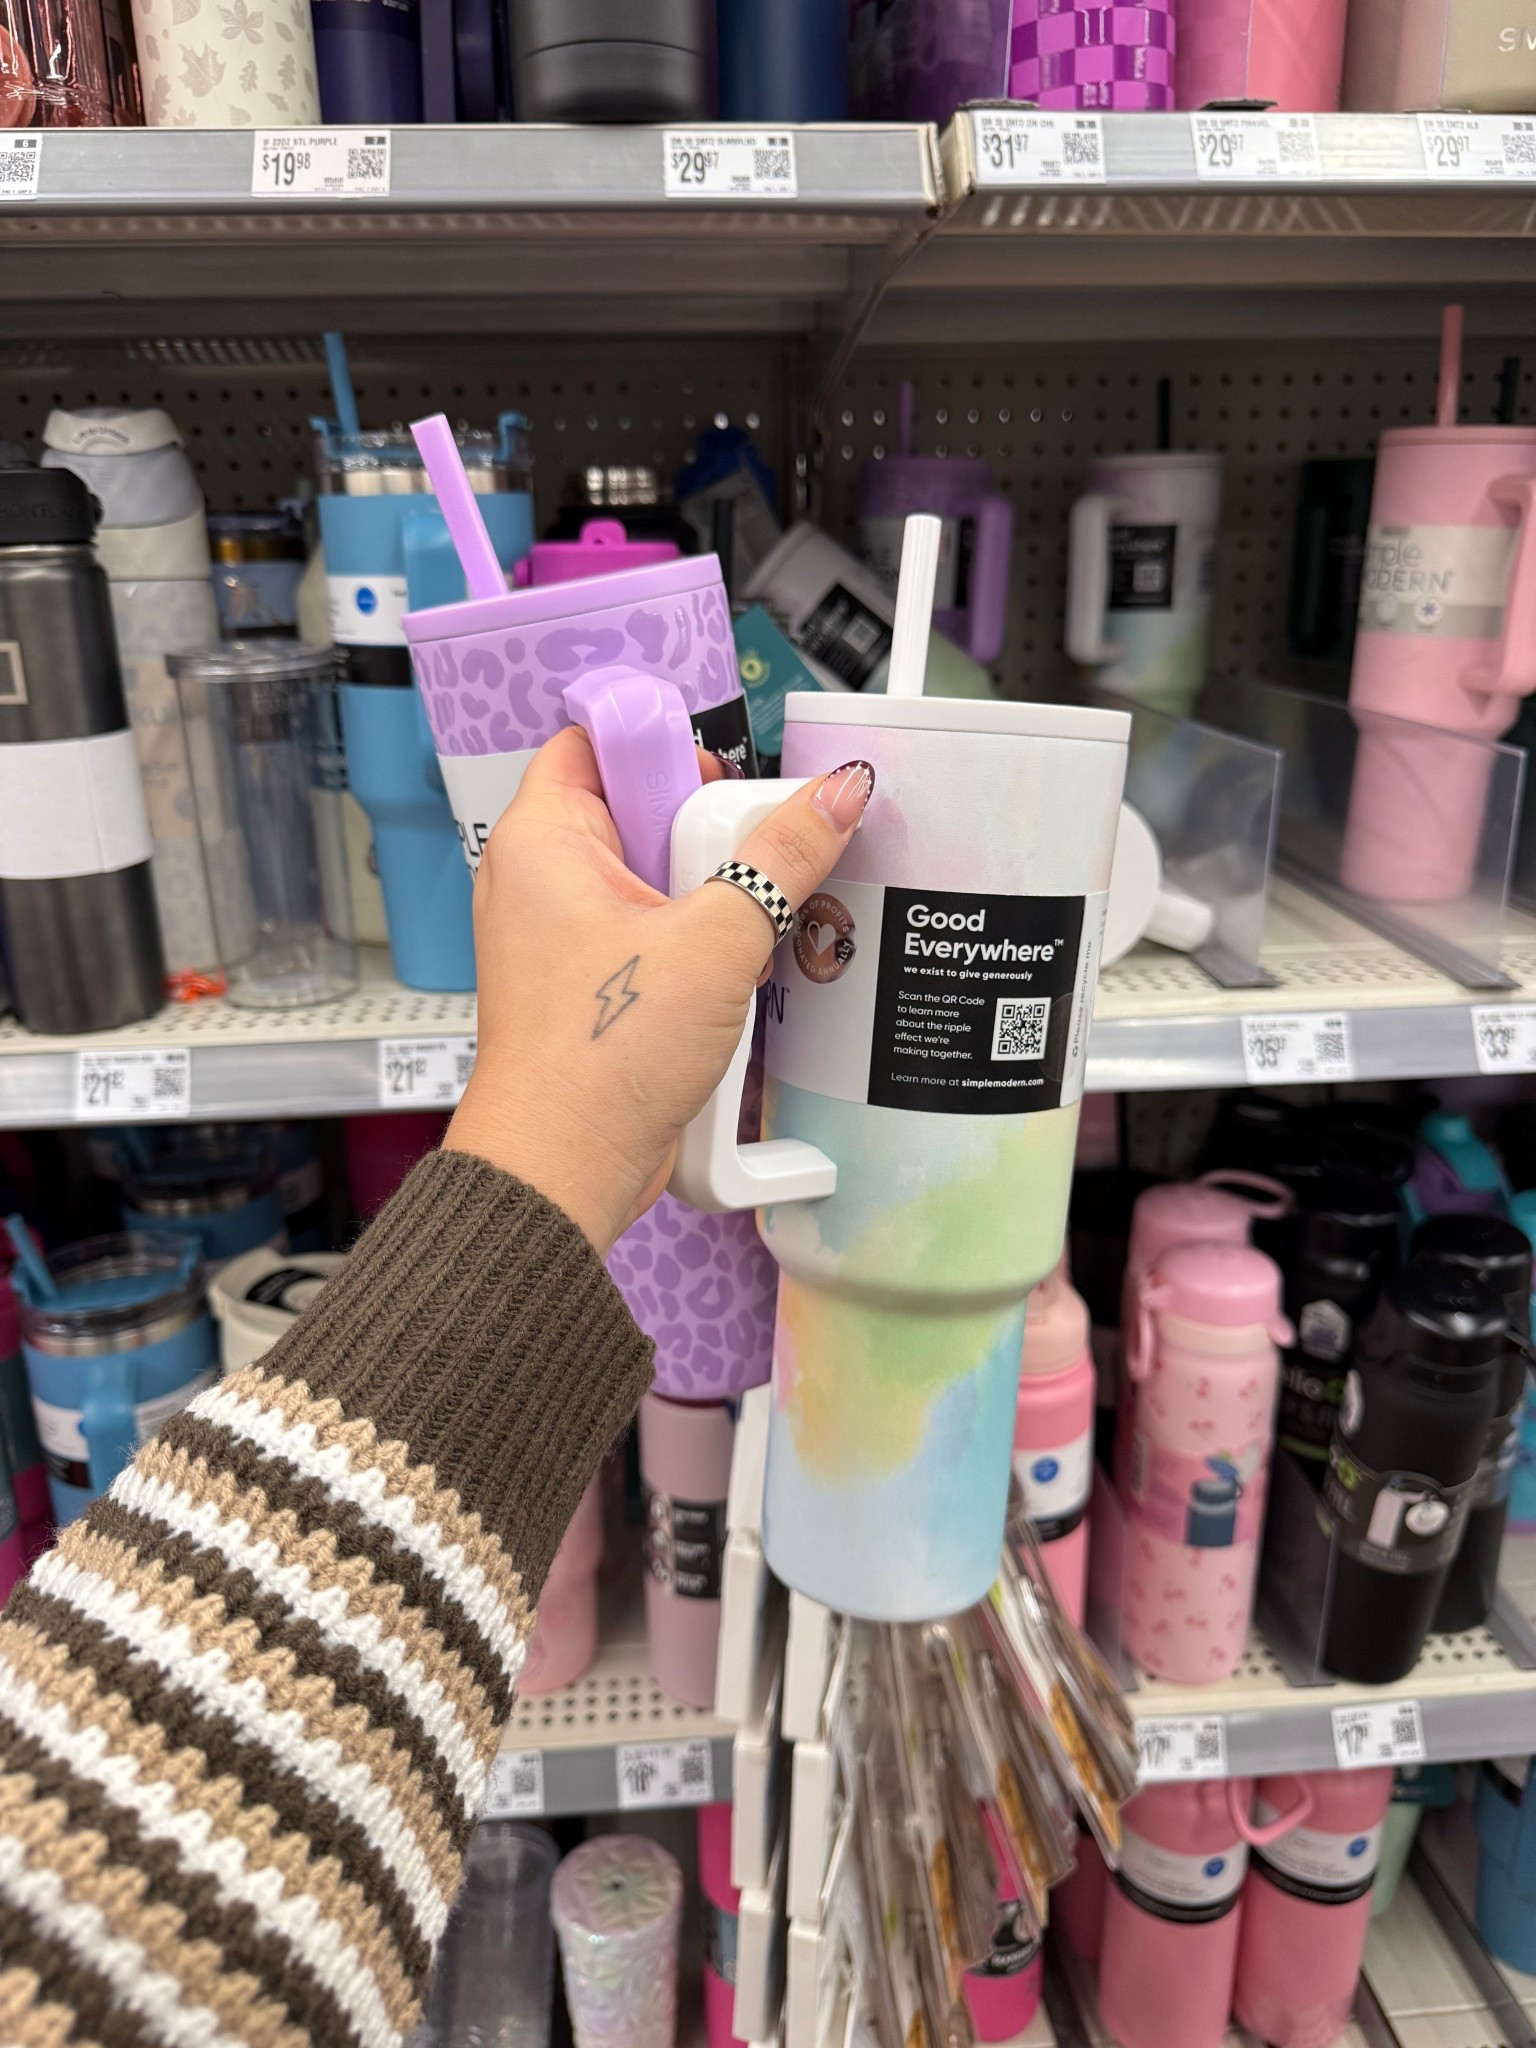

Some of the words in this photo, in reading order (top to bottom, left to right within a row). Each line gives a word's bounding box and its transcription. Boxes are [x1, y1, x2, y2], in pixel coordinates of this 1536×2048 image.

[821, 901, 850, 933] PROFITS
[907, 904, 986, 932] Good
[817, 940, 850, 976] ANNUALLY
[903, 965, 918, 974] we
[920, 966, 944, 976] exist
[946, 969, 957, 977] to
[959, 969, 980, 980] give
[982, 970, 1033, 981] generously
[898, 990, 923, 1001] Scan
[924, 993, 941, 1003] the
[941, 994, 957, 1004] QR
[958, 995, 985, 1006] Code
[897, 1005, 908, 1014] to
[908, 1005, 933, 1016] learn
[934, 1009, 960, 1018] more
[895, 1018, 925, 1030] about
[926, 1020, 943, 1031] the
[944, 1022, 972, 1034] ripple
[894, 1032, 922, 1043] effect
[893, 1045, 928, 1059] making
[930, 1048, 973, 1060] together.
[891, 1072, 919, 1084] Learn
[920, 1077, 947, 1086] more
[948, 1078, 960, 1087] at
[961, 1077, 1045, 1090] simplemodern.com
